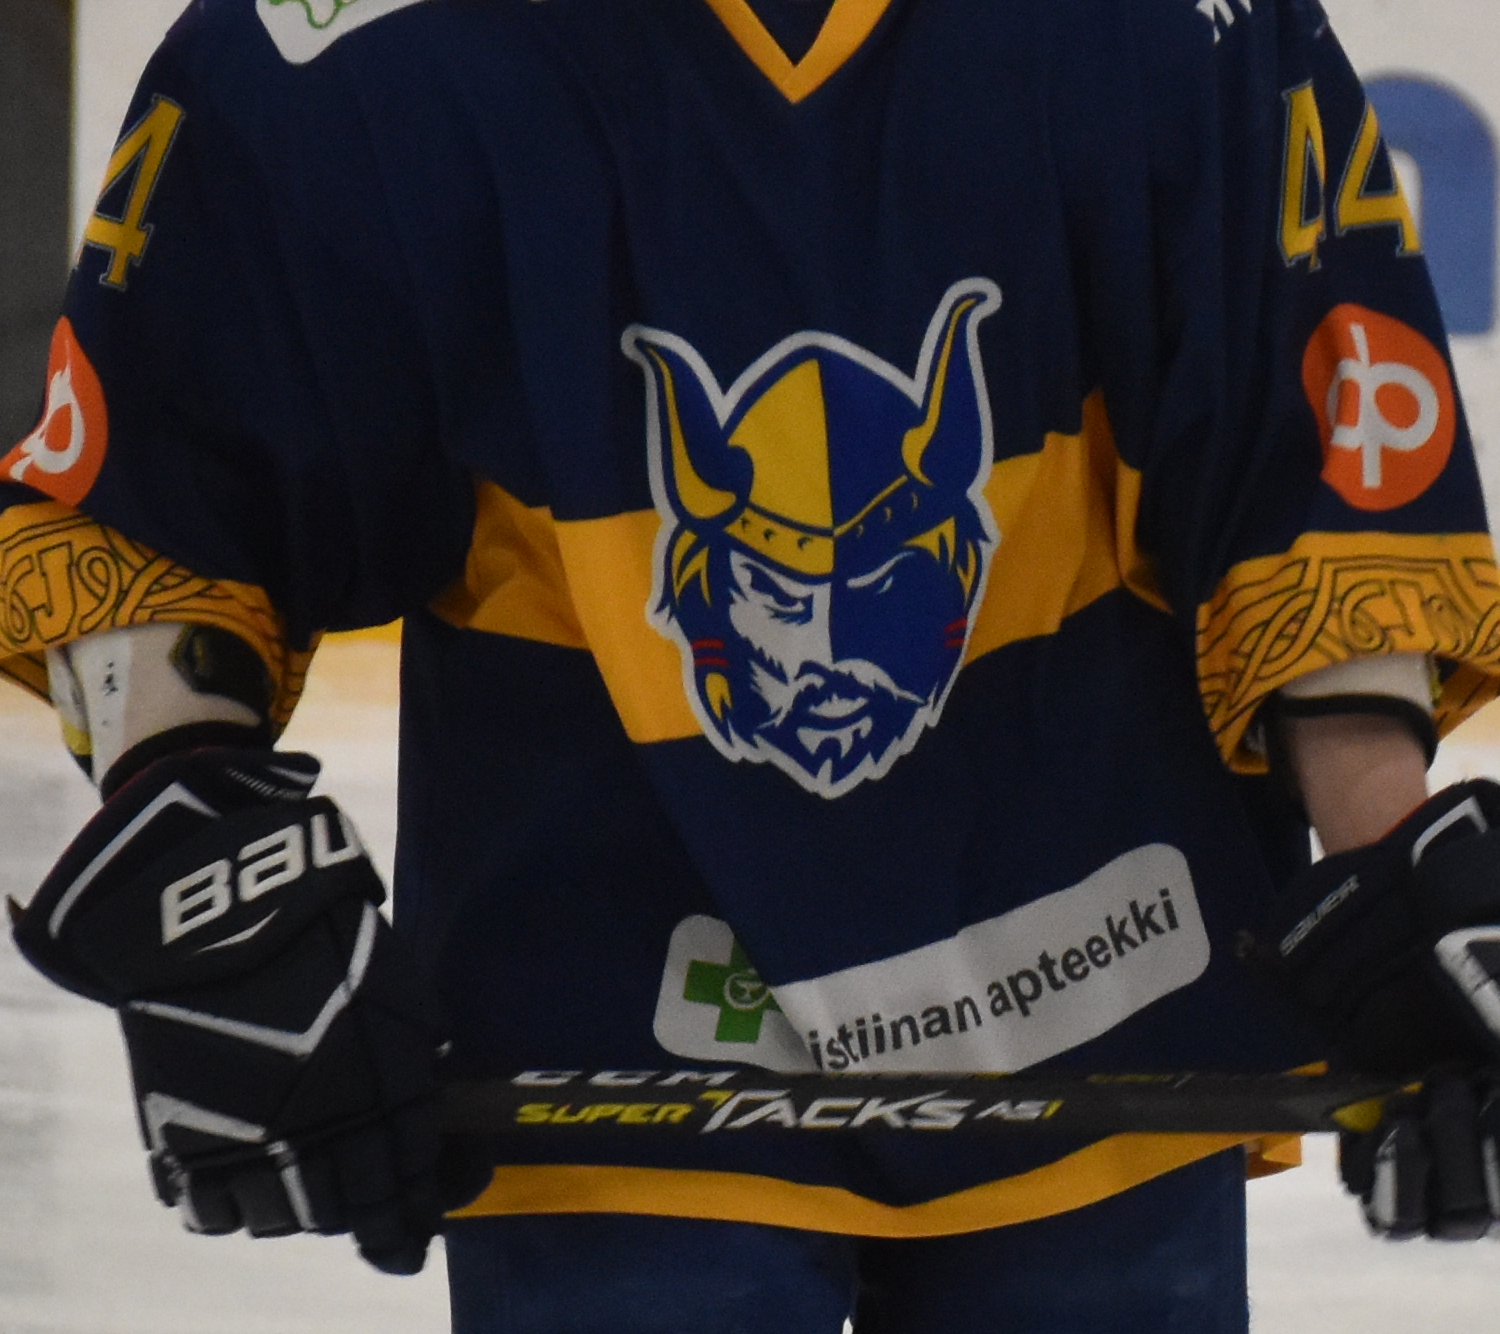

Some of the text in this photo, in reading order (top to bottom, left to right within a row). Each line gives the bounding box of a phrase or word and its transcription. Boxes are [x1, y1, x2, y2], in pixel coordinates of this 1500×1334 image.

[159, 814, 363, 946] BAU
[806, 888, 1180, 1071] istiinan apteekki
[516, 1102, 696, 1125] SUPER
[699, 1088, 977, 1135] TACKS
